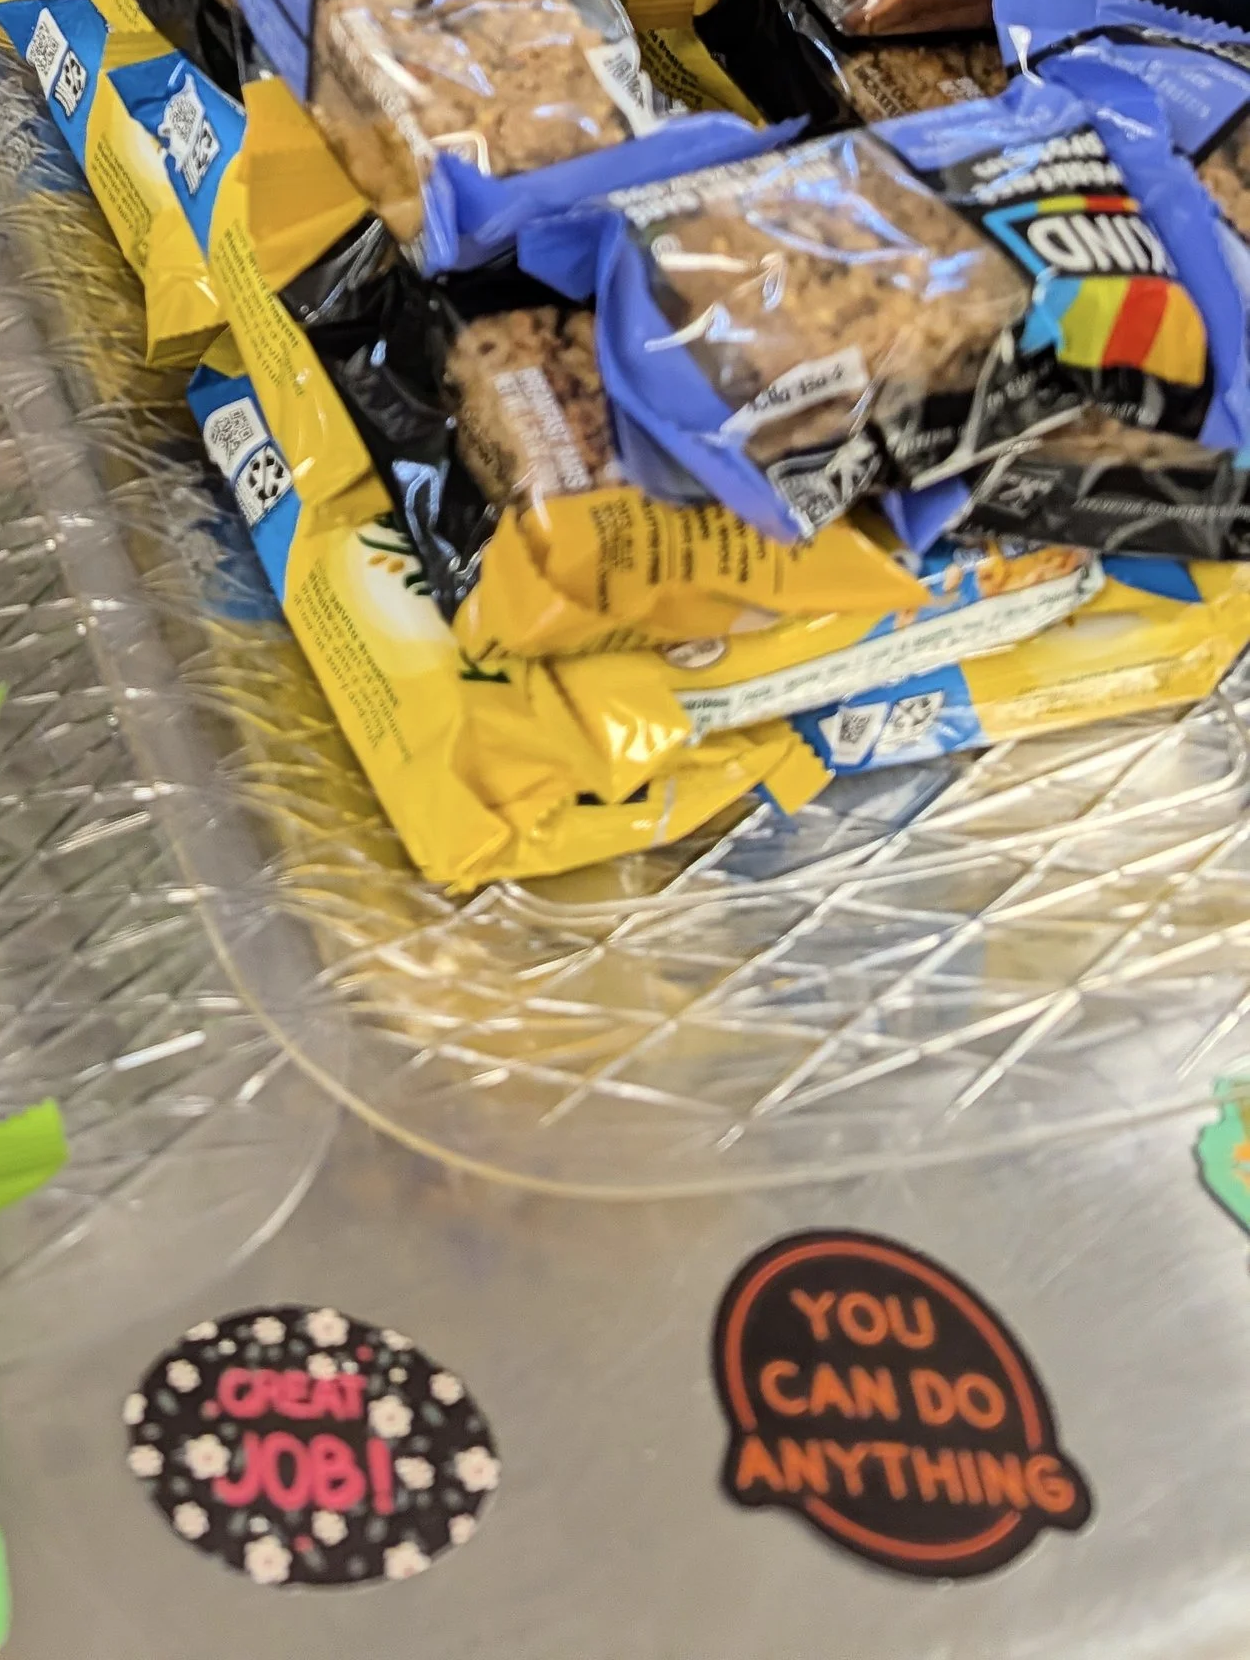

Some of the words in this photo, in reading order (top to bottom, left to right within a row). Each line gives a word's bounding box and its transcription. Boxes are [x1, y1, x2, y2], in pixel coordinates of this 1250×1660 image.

[789, 1287, 937, 1350] YOU
[759, 1358, 900, 1422] CAN
[909, 1367, 1007, 1430] DO
[211, 1428, 395, 1515] JOB!
[735, 1433, 1077, 1514] ANYTHING
